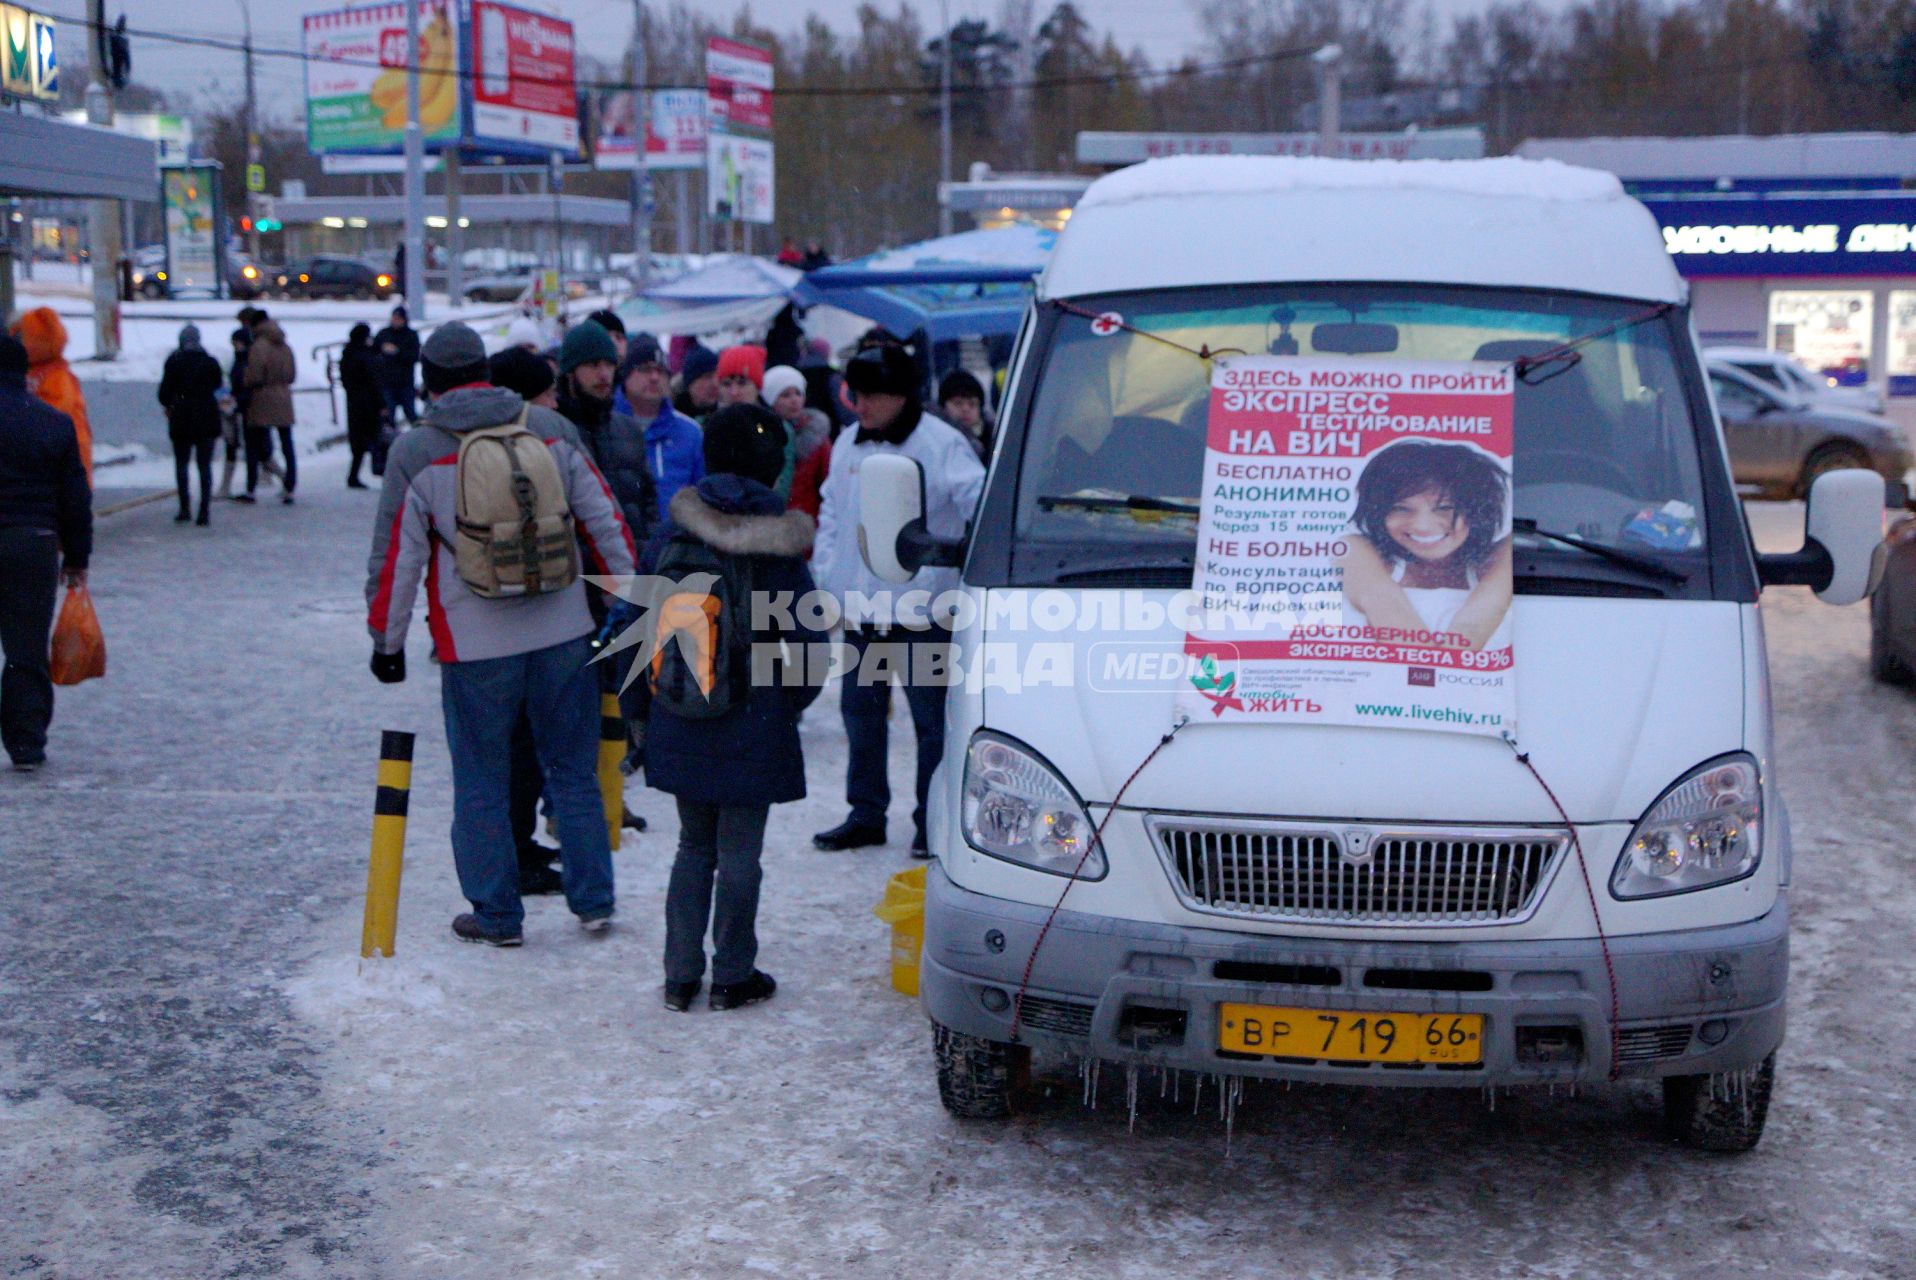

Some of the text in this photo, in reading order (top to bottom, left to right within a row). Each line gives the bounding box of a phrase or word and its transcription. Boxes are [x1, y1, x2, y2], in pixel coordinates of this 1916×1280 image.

[1224, 370, 1507, 391] ЗДЕСЬ МОЖНО ПРОЙТИ
[1222, 391, 1390, 414] ЭКСПРЕСС
[1297, 413, 1493, 434] ТЕСТИРОВАНИЕ
[1228, 430, 1361, 456] НА ВИЧ
[1216, 462, 1352, 481] БЕСПЛАТНО
[1214, 484, 1350, 503] АНОНИМНО
[1214, 504, 1347, 521] Результат готов
[1213, 520, 1346, 534] через 15 минут
[1209, 538, 1348, 557] НЕ БОЛЬНО
[1207, 561, 1344, 578] Консультация
[1236, 581, 1344, 595] ВОПРОСАМ
[1203, 596, 1343, 613] ВИЧ-инфекции
[1289, 624, 1472, 648] ДОСТОВЕРНОСТЬ
[1289, 643, 1511, 669] ЭКСПРЕСС-ТЕСТА 99%
[1438, 673, 1504, 687] РОССИЯ
[1239, 689, 1296, 700] чтобы
[1248, 699, 1322, 713] ЖИТЬ
[1355, 703, 1502, 726] www.livehiv.ru
[1317, 1015, 1396, 1054] 719
[1425, 1018, 1466, 1046] 66
[1429, 1050, 1459, 1058] RUS
